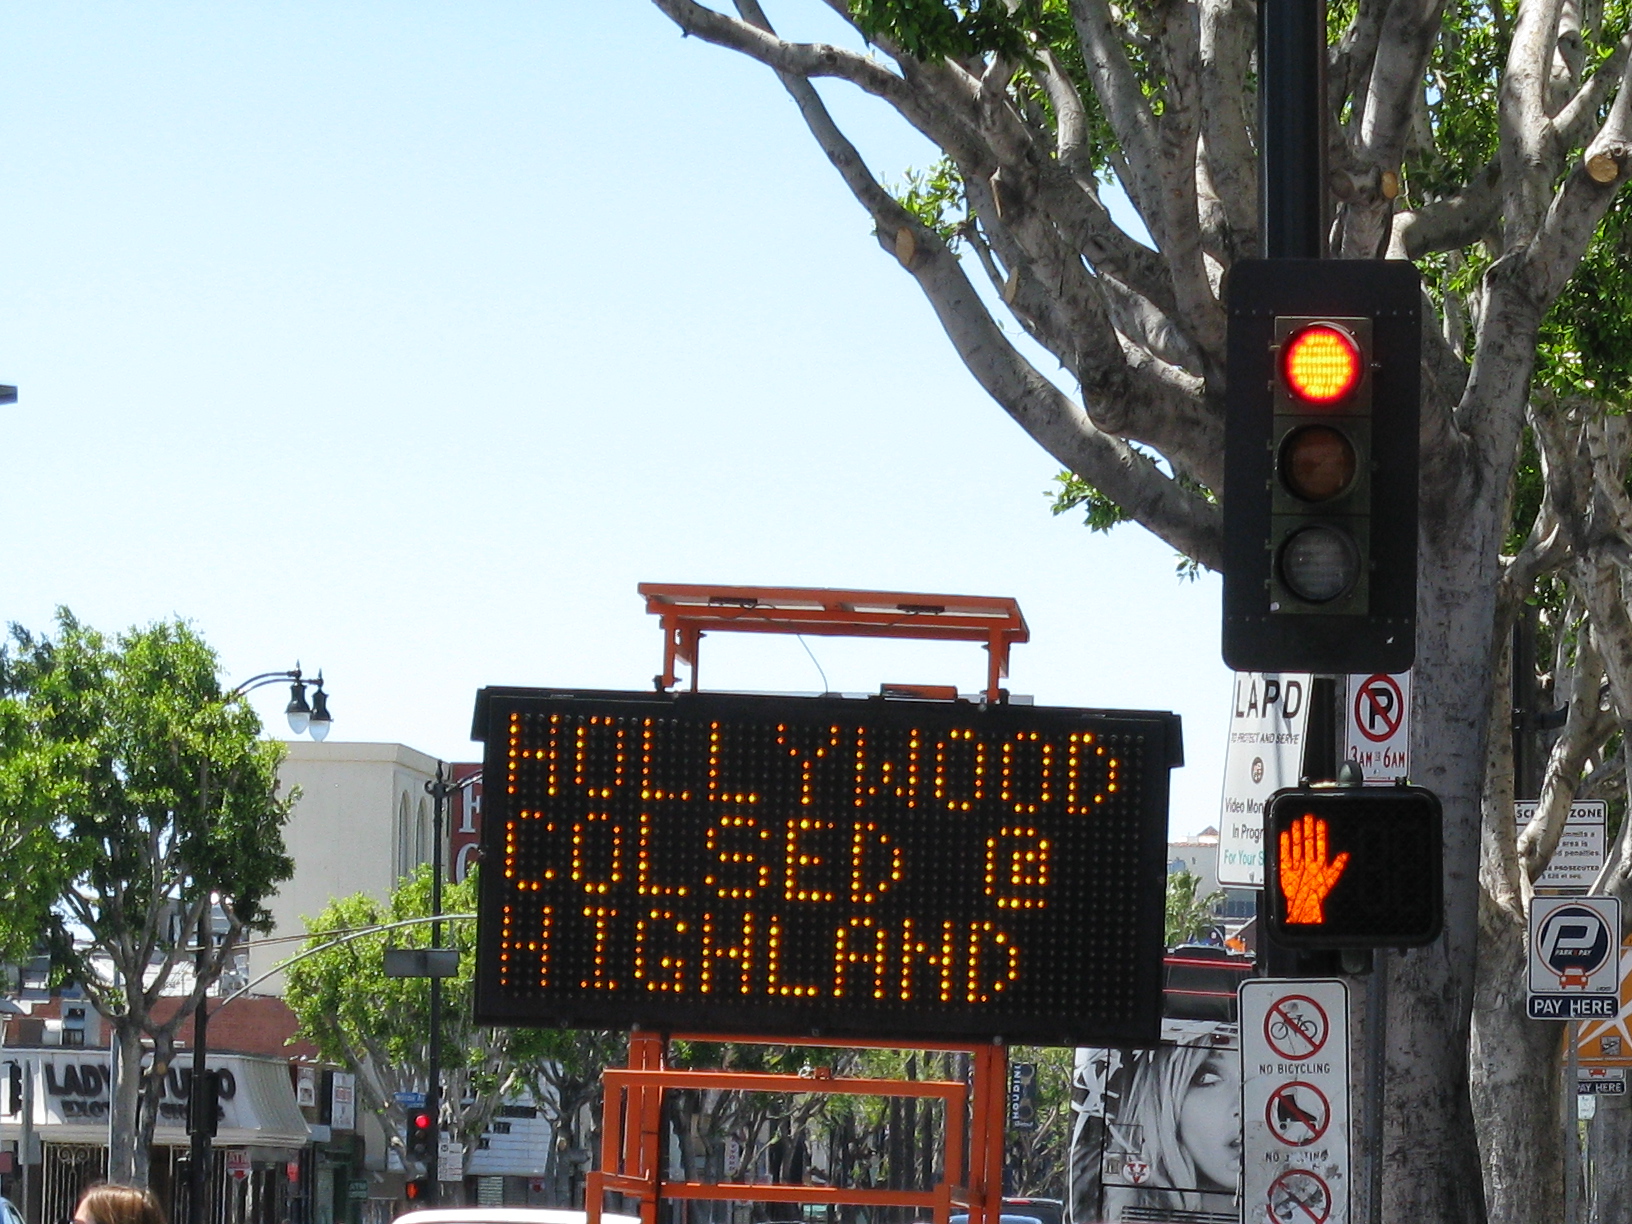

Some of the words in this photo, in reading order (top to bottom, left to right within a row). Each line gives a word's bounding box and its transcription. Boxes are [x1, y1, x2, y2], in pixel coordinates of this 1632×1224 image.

[1235, 680, 1303, 718] LAPD
[1260, 732, 1275, 744] AND
[1275, 732, 1300, 745] SERVE
[507, 713, 1118, 814] HOLLYWOOD
[1383, 746, 1405, 768] 6AM
[1225, 798, 1245, 814] Video
[1246, 798, 1264, 814] Mon
[1570, 808, 1603, 818] ZONE
[1232, 823, 1240, 839] In
[1241, 823, 1264, 844] Progr
[504, 811, 901, 902] COLSED
[986, 826, 1049, 908] @
[1224, 850, 1236, 865] For
[1238, 850, 1257, 865] Your
[501, 905, 1016, 1001] HIGHLAND
[1534, 999, 1563, 1014] PAY
[1571, 999, 1613, 1015] HERE
[1259, 1064, 1273, 1074] NO
[1277, 1063, 1331, 1074] BICYCLING
[1595, 1082, 1622, 1092] HERE
[1265, 1151, 1279, 1162] NO
